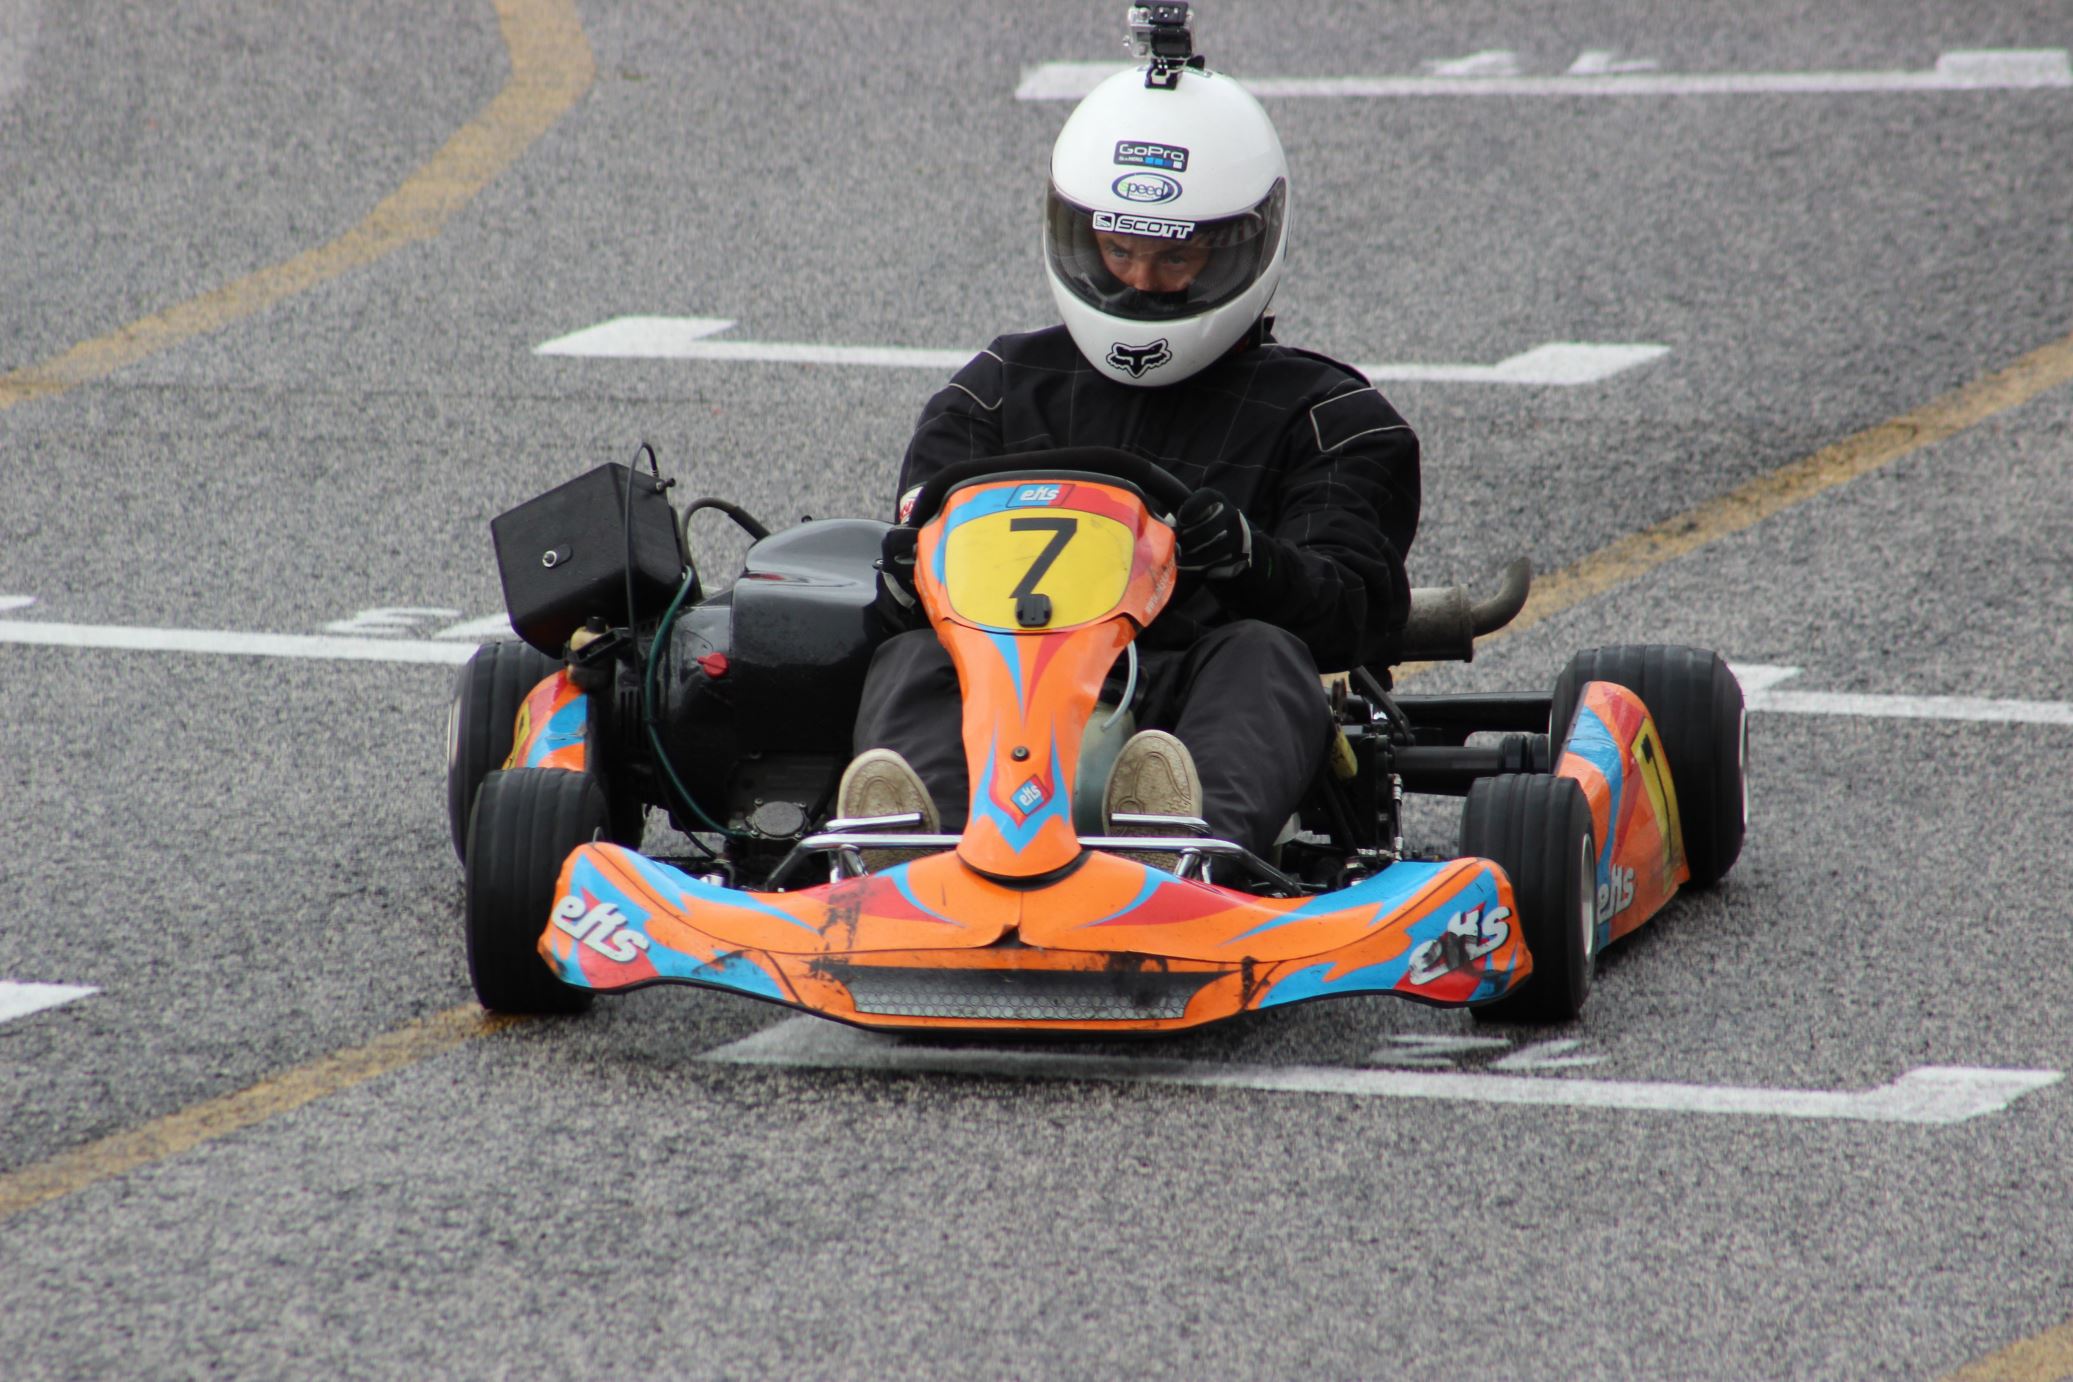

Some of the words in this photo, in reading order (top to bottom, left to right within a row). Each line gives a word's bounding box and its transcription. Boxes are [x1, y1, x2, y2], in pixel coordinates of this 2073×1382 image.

[1119, 143, 1184, 161] GoPro
[1118, 180, 1166, 198] speed
[1117, 218, 1192, 237] SCOTT
[1009, 516, 1078, 600] 7
